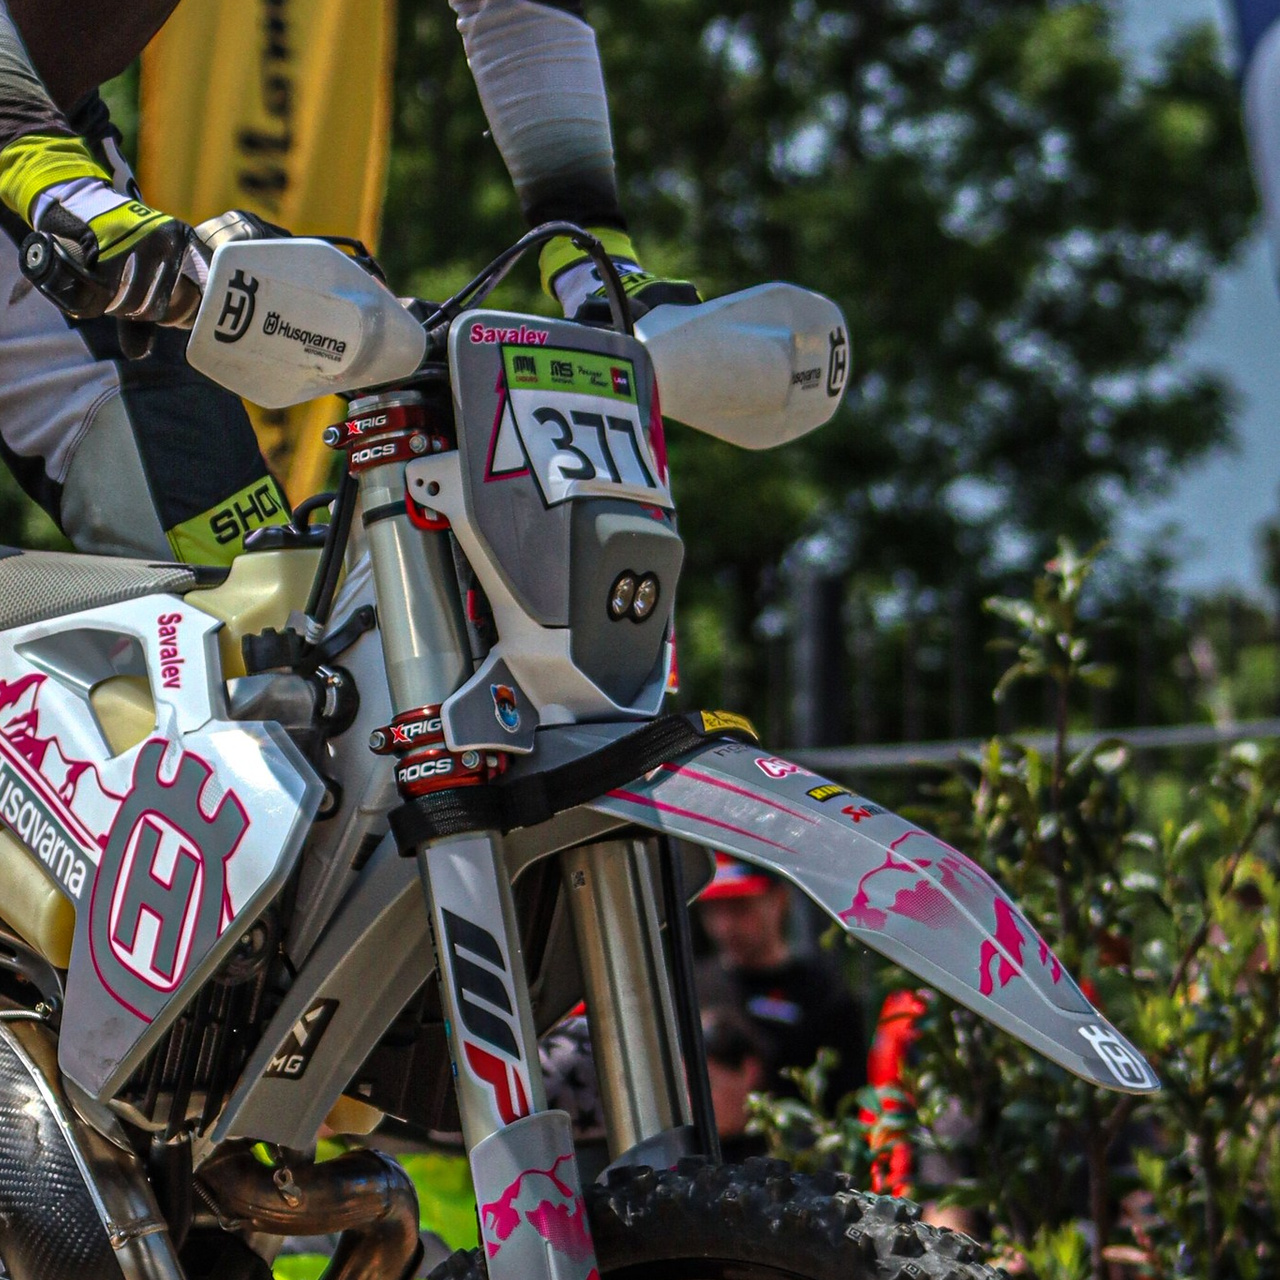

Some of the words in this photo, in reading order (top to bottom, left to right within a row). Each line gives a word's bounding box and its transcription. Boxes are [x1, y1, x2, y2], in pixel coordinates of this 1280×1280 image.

[279, 320, 347, 354] Husqvarna
[345, 414, 387, 436] XTRIG
[351, 442, 396, 464] ROCS
[532, 406, 658, 489] 377
[157, 612, 183, 690] Savalev
[390, 718, 443, 744] XTRIG
[398, 758, 452, 783] ROCS
